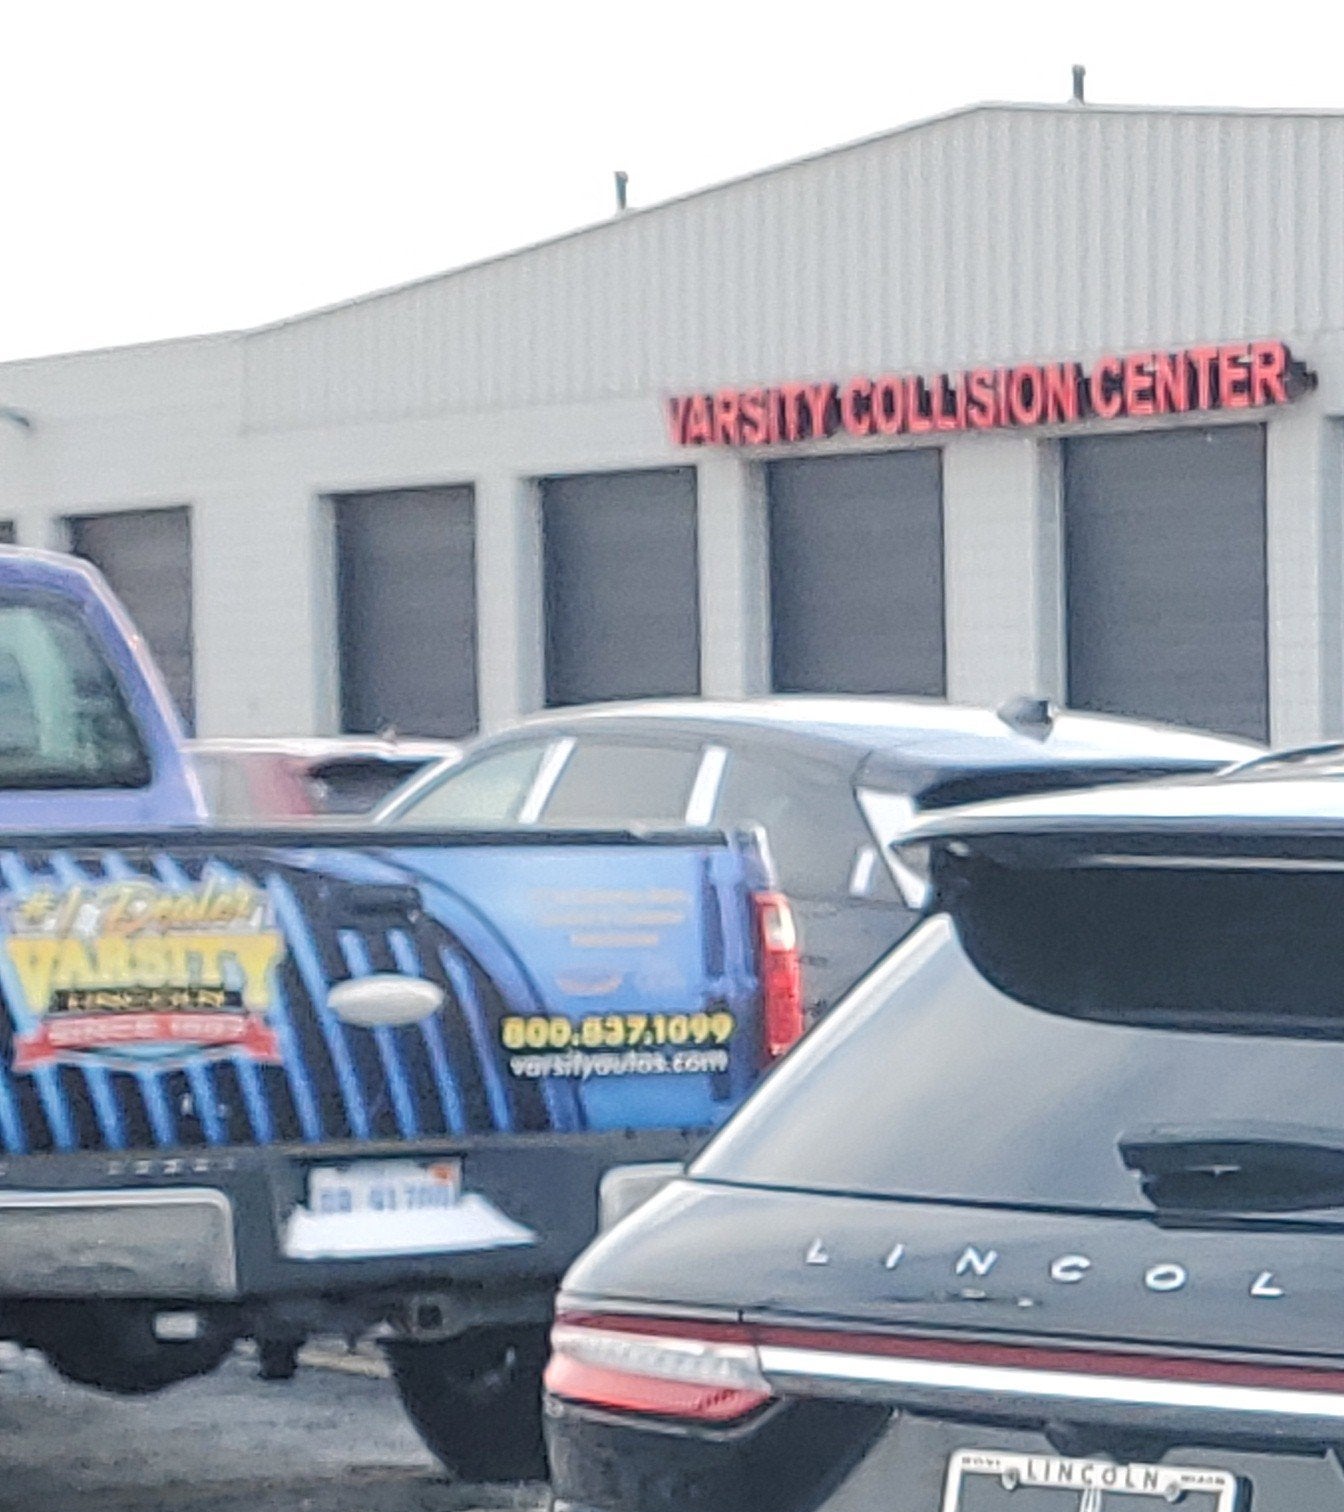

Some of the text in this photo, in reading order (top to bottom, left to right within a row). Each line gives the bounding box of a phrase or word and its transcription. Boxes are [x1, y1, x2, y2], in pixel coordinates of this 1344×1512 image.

[665, 340, 1293, 446] VARSITY COLLISION CENTER
[6, 935, 283, 1012] VARSITY
[502, 1012, 733, 1049] 800.837.1099
[510, 1049, 728, 1081] varsityautos.com
[1026, 1459, 1159, 1491] LINCOLN
